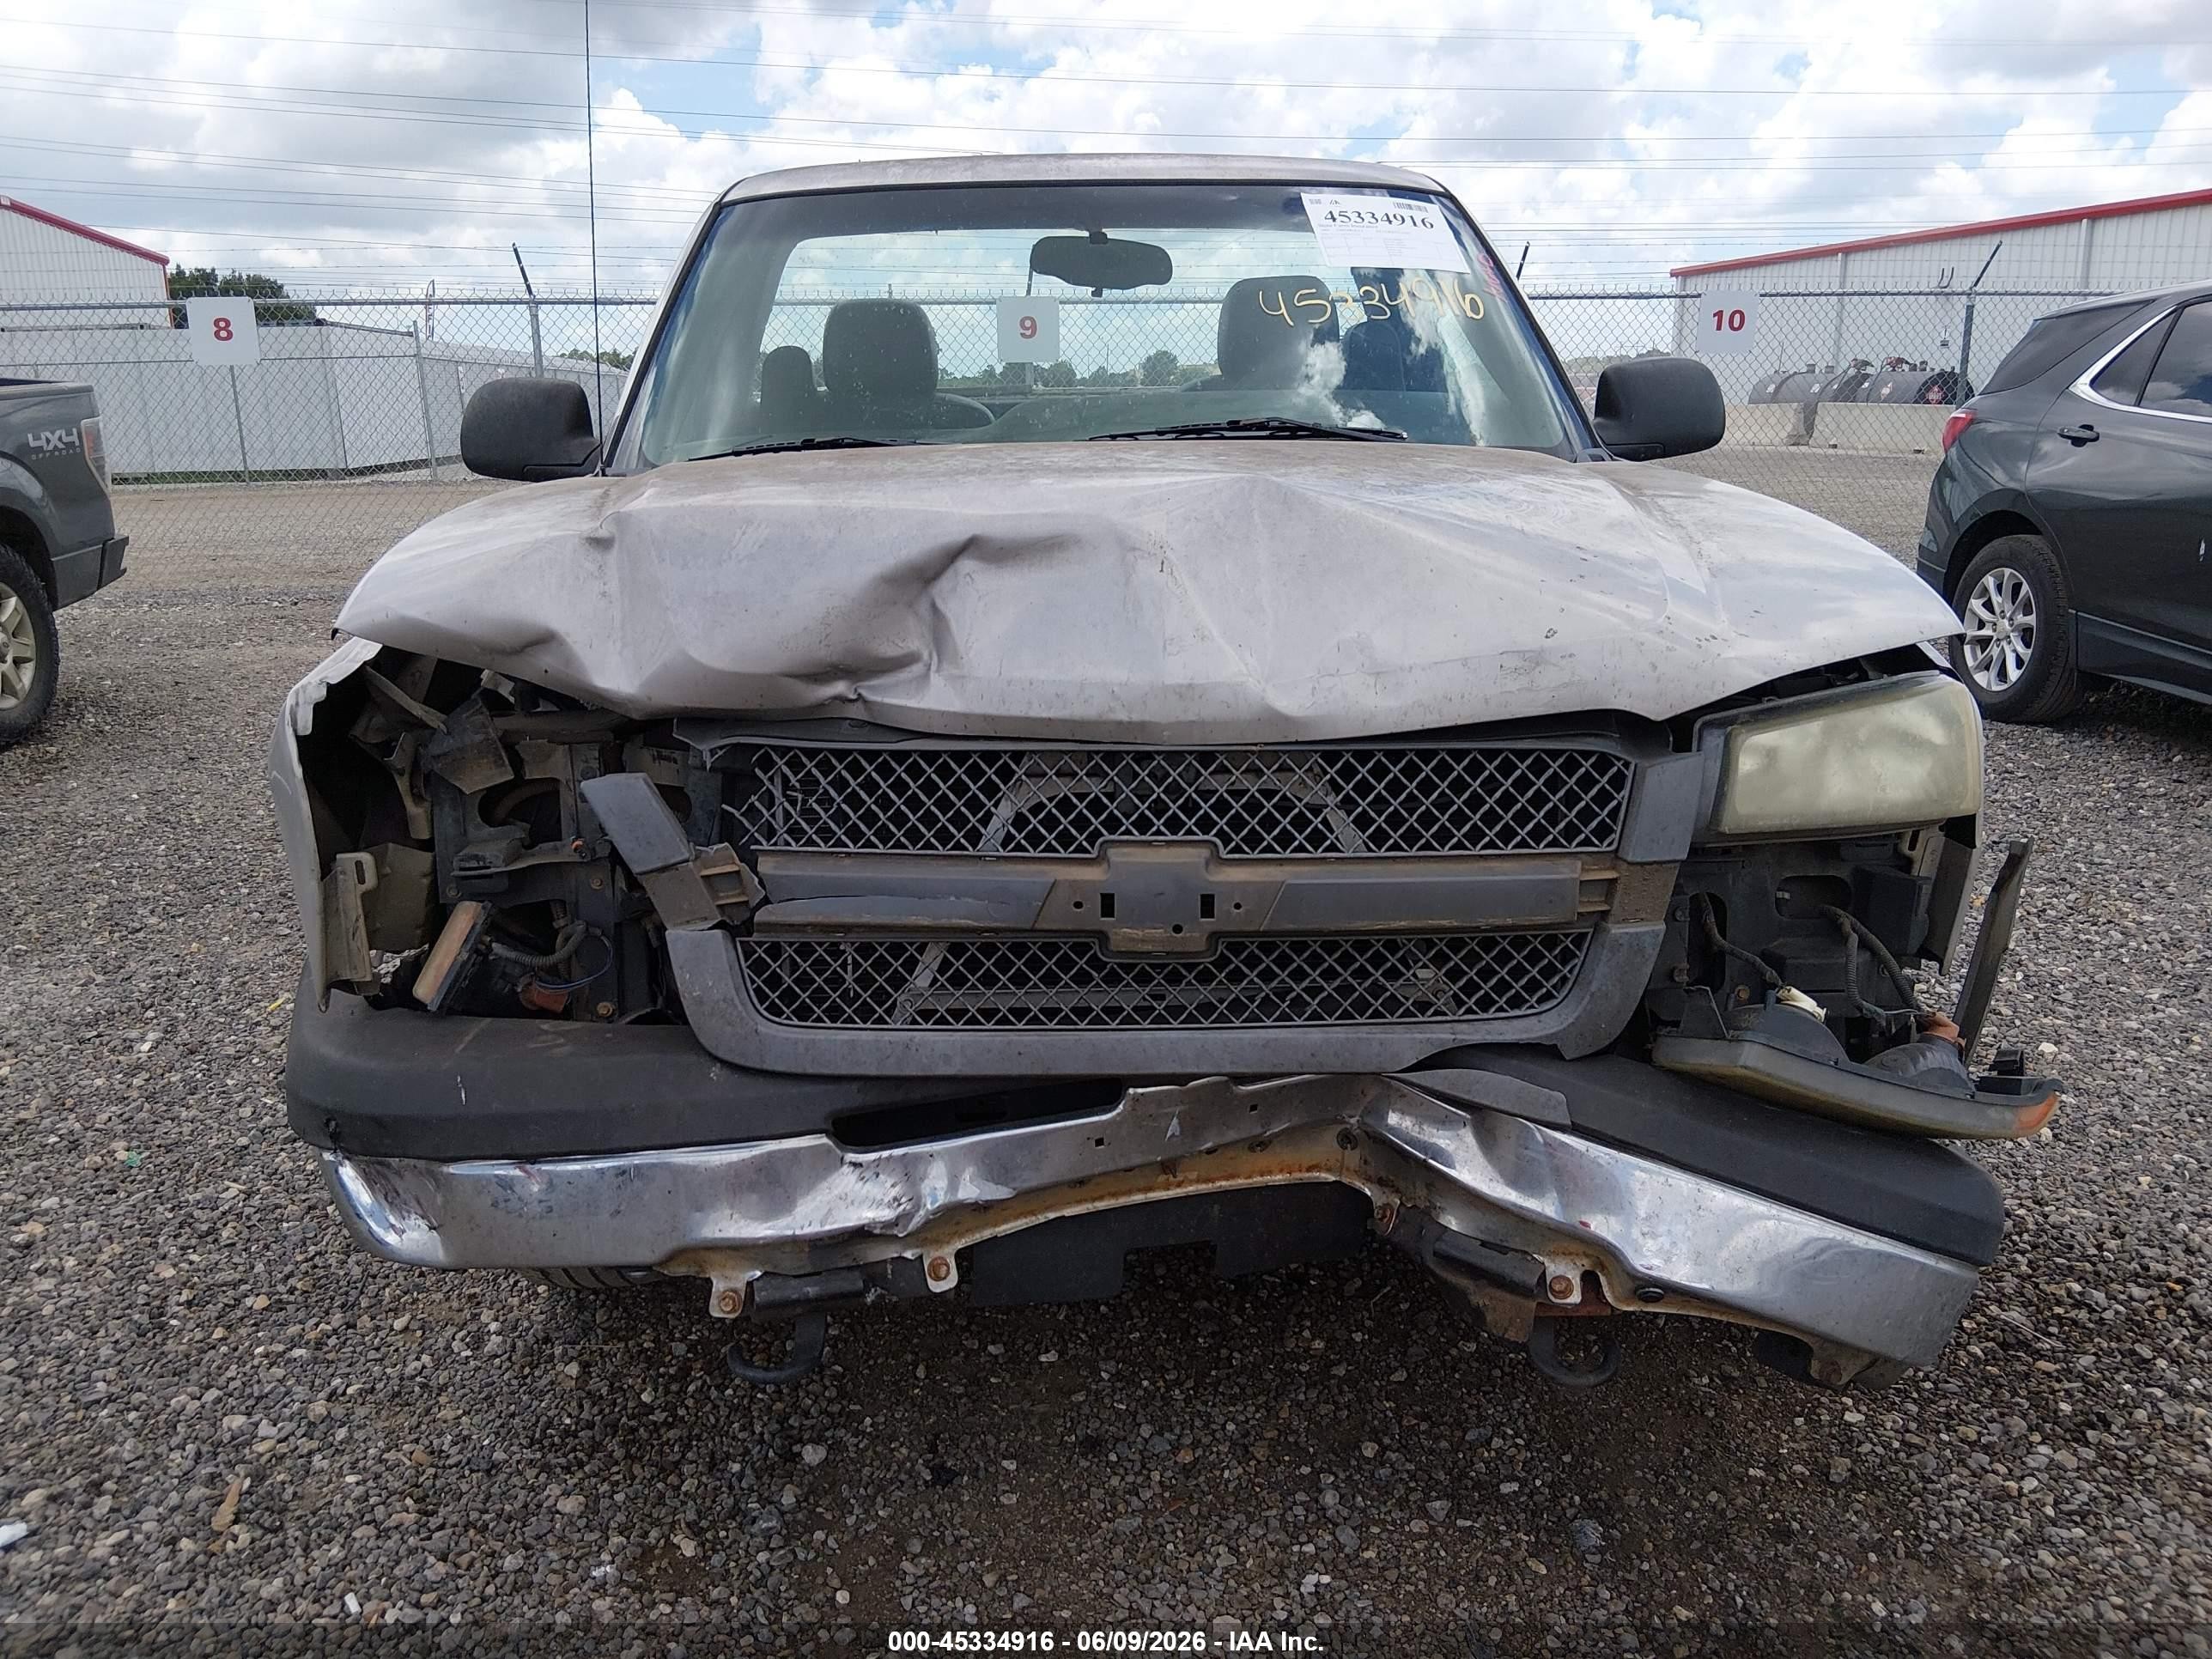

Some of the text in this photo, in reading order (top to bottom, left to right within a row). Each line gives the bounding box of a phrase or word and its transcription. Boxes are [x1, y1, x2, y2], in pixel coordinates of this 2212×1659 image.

[1324, 210, 1434, 229] 45334916
[213, 317, 234, 342] 8
[1019, 315, 1037, 339] 9
[1712, 309, 1746, 331] 10
